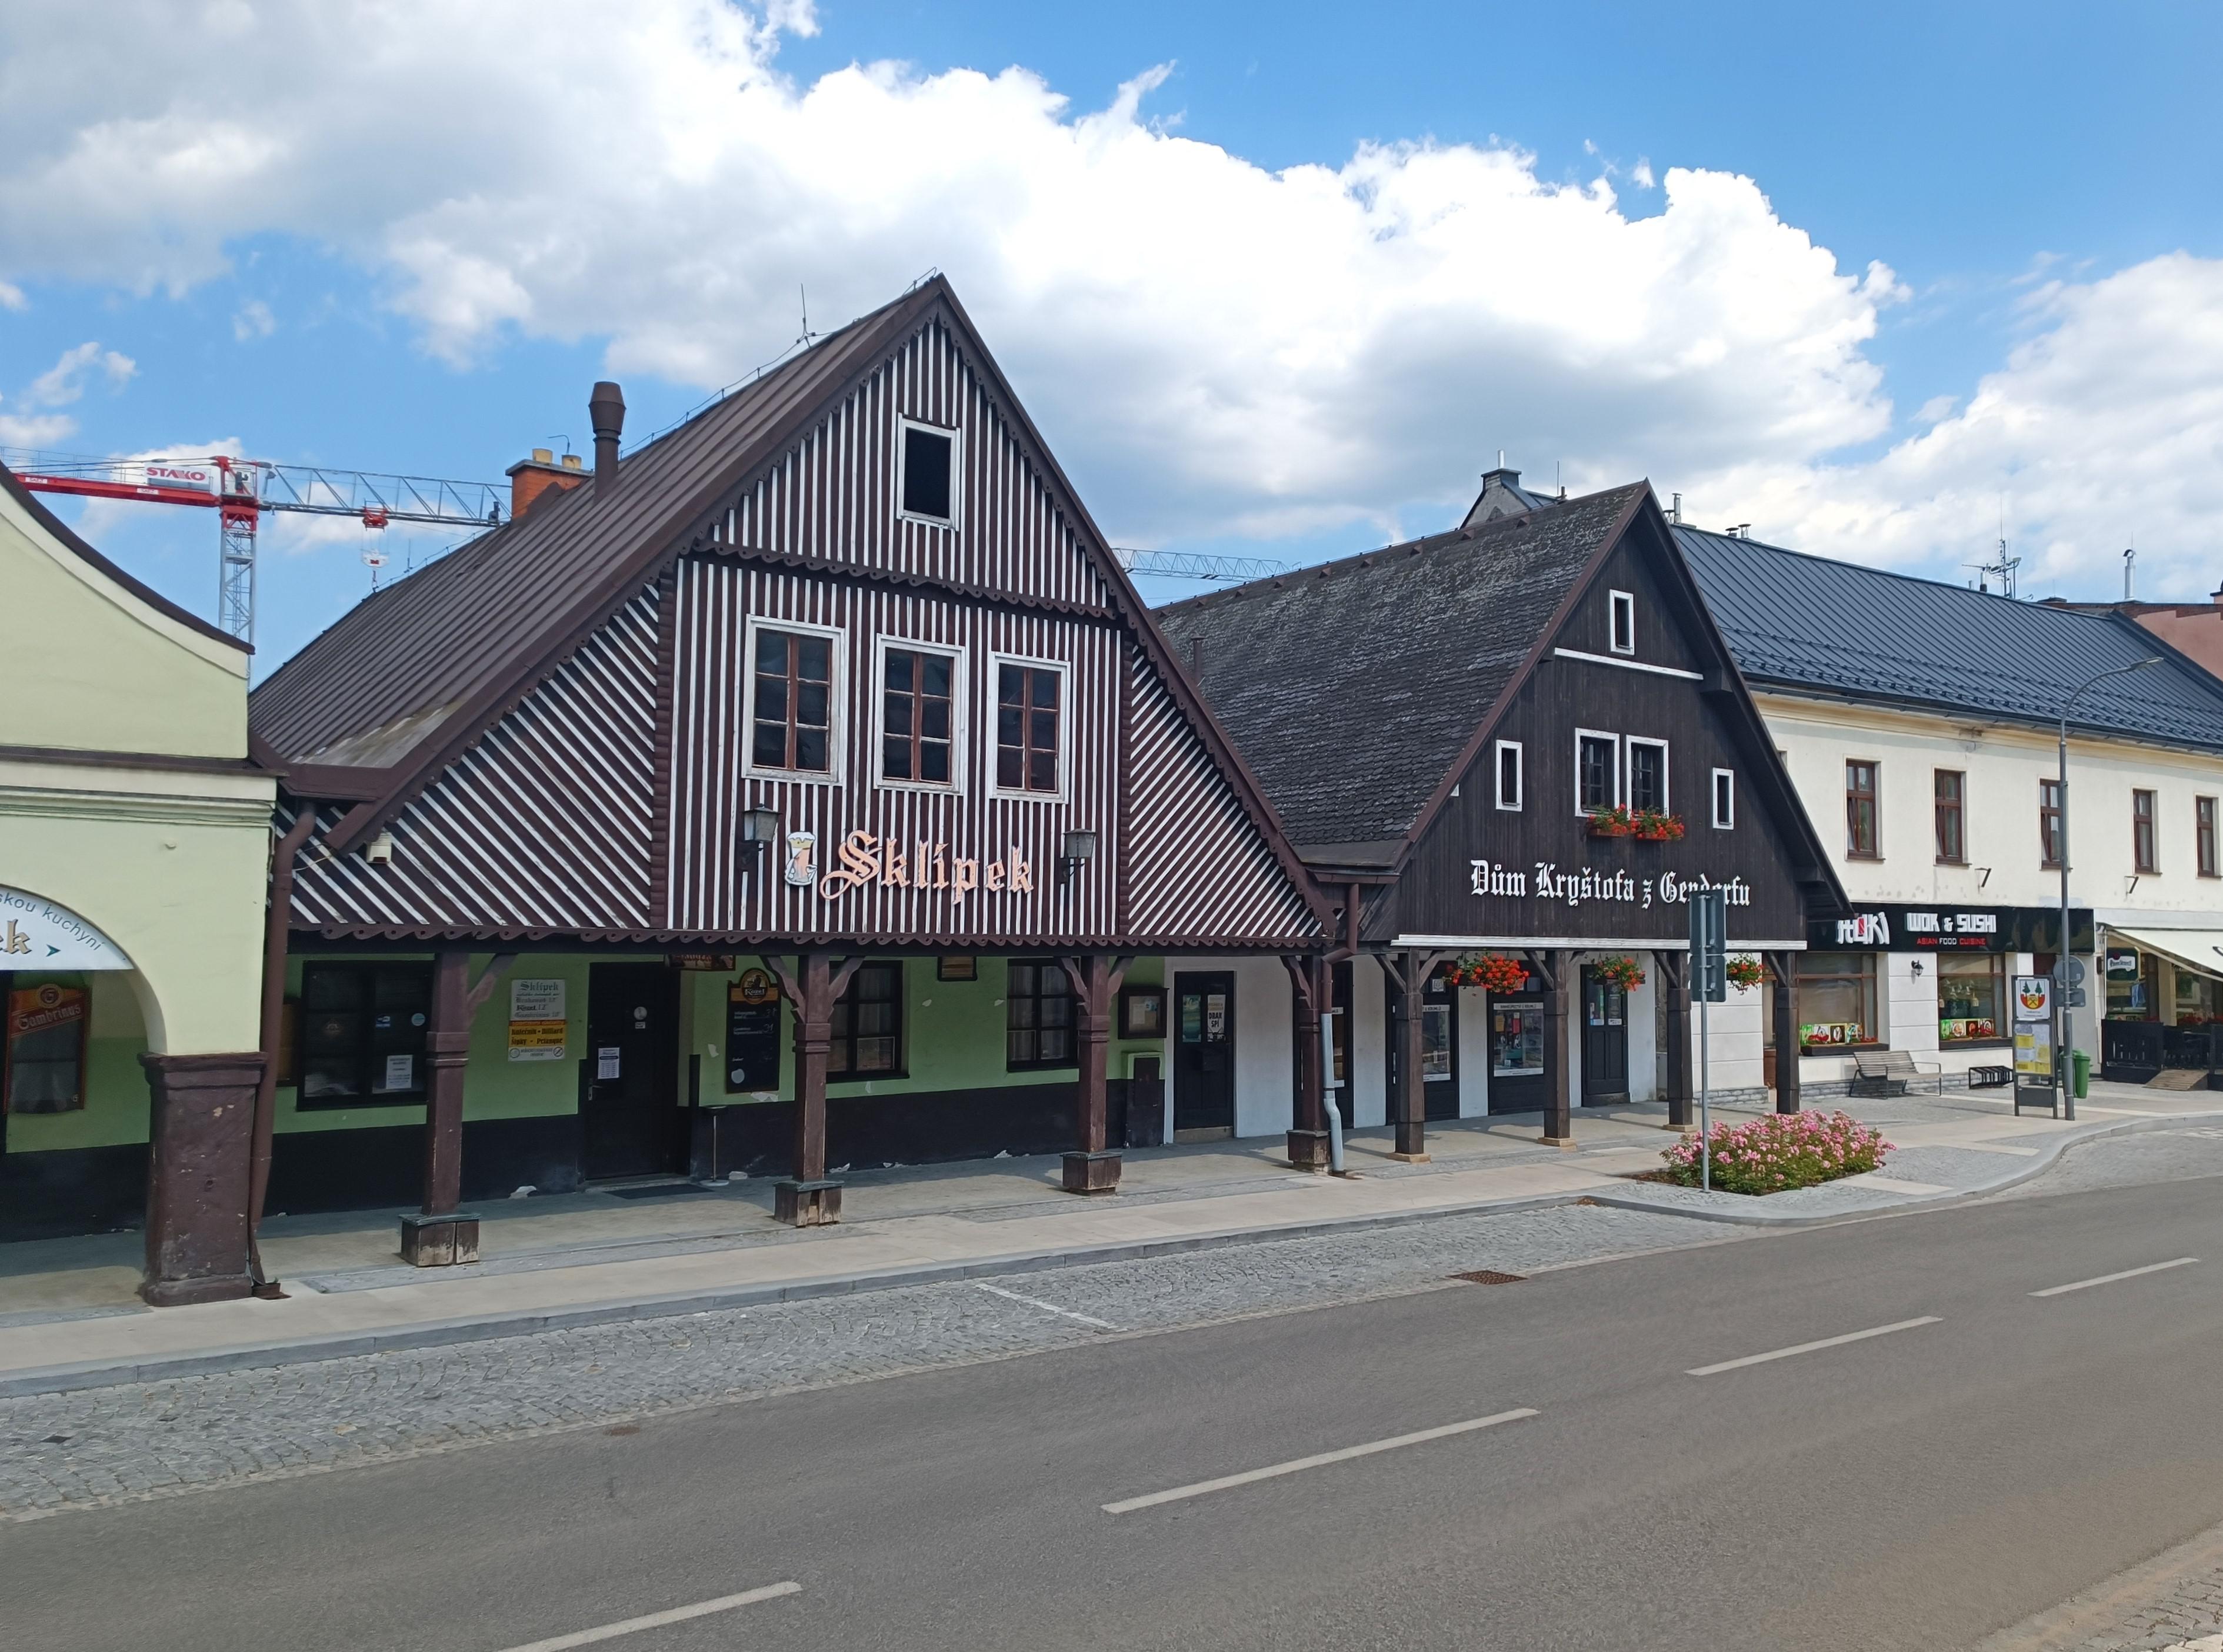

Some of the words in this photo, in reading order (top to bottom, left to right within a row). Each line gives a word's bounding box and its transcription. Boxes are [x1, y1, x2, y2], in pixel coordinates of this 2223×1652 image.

[146, 467, 206, 481] STAKO
[819, 830, 1034, 905] Sklípek
[1471, 859, 1527, 897] Dům
[1535, 862, 1635, 907] Kryštofa
[1642, 879, 1654, 910] z
[42, 904, 105, 950] kuchyní
[1905, 912, 1940, 932] WOK
[1943, 917, 1953, 932] &
[1955, 913, 1997, 933] SUSHI
[18, 1004, 81, 1030] Gambrinus
